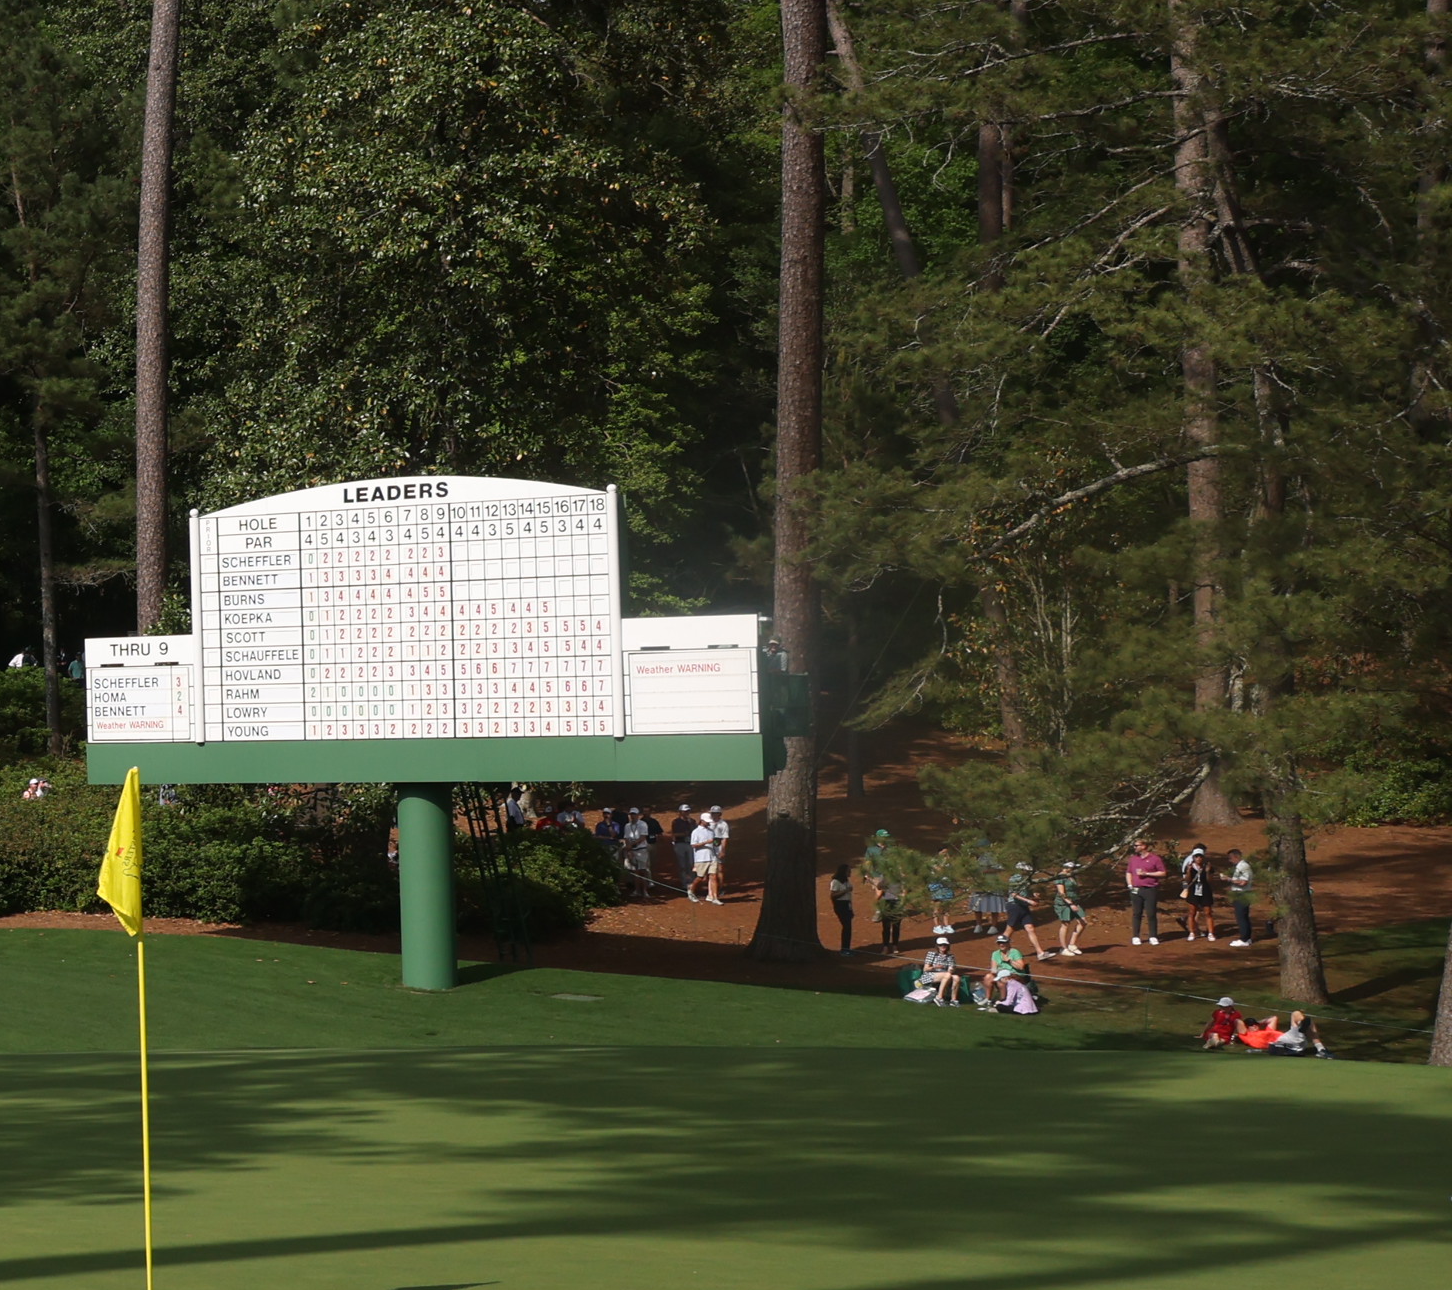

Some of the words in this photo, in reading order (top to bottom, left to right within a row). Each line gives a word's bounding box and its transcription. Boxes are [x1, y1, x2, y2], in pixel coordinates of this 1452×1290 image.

[344, 482, 448, 503] LEADERS
[239, 518, 277, 531] HOLE
[320, 514, 327, 527] 2
[336, 513, 344, 526] 3
[351, 513, 359, 524] 4
[367, 512, 375, 524] 5
[384, 510, 393, 523] 6
[403, 509, 411, 521] 7
[420, 508, 429, 521] 8
[436, 507, 445, 520] 9
[451, 506, 466, 519] 10
[470, 506, 480, 517] 11
[485, 504, 498, 517] 12
[502, 503, 516, 516] 13
[519, 503, 534, 515] 14
[536, 501, 551, 514] 15
[555, 500, 569, 513] 16
[572, 499, 586, 512] 17
[590, 498, 605, 511] 18
[246, 537, 272, 549] PAR
[305, 534, 312, 545] 4
[321, 533, 328, 545] 5
[336, 532, 344, 543] 4
[352, 531, 361, 544] 3
[368, 531, 376, 542] 4
[385, 529, 394, 542] 3
[404, 528, 412, 540] 4
[421, 527, 429, 540] 5
[437, 527, 445, 538] 4
[455, 526, 463, 537] 4
[471, 525, 480, 536] 4
[488, 523, 497, 536] 3
[506, 522, 514, 535] 5
[523, 522, 532, 533] 4
[540, 520, 548, 533] 5
[558, 519, 567, 532] 3
[576, 519, 584, 531] 4
[593, 518, 602, 530] 4
[222, 554, 291, 568] SCHEFFLER
[323, 552, 329, 564] 2
[338, 552, 343, 563] 2
[355, 551, 360, 562] 2
[370, 550, 375, 561] 2
[385, 549, 391, 560] 2
[408, 548, 413, 559] 2
[422, 547, 427, 559] 2
[438, 546, 444, 558] 3
[224, 574, 278, 586] BENNETT
[324, 571, 329, 583] 3
[339, 571, 344, 582] 3
[356, 570, 361, 581] 3
[371, 569, 376, 581] 3
[386, 568, 391, 579] 4
[408, 567, 413, 578] 4
[423, 567, 428, 577] 4
[439, 566, 444, 576] 4
[224, 594, 264, 606] BURNS
[324, 591, 329, 602] 3
[338, 590, 343, 601] 4
[356, 590, 360, 600] 4
[370, 589, 375, 599] 4
[386, 588, 391, 599] 4
[407, 588, 412, 598] 4
[423, 586, 429, 598] 5
[440, 586, 445, 597] 5
[224, 613, 272, 624] KOEPKA
[339, 609, 345, 620] 2
[356, 609, 362, 620] 2
[371, 608, 377, 619] 2
[387, 607, 392, 619] 2
[409, 606, 414, 618] 3
[423, 606, 428, 616] 4
[440, 606, 445, 616] 4
[459, 605, 464, 615] 4
[476, 604, 481, 615] 4
[491, 603, 496, 615] 5
[511, 603, 516, 613] 4
[526, 602, 531, 613] 4
[543, 601, 548, 613] 5
[226, 632, 265, 643] SCOTT
[340, 628, 345, 640] 2
[357, 628, 362, 639] 2
[372, 627, 377, 638] 2
[387, 627, 393, 638] 2
[410, 626, 415, 637] 2
[424, 625, 429, 636] 2
[440, 625, 446, 636] 2
[460, 624, 465, 636] 2
[475, 624, 480, 635] 2
[492, 623, 497, 635] 2
[511, 622, 517, 634] 2
[527, 621, 532, 633] 3
[543, 621, 549, 633] 5
[563, 620, 569, 632] 5
[580, 620, 586, 631] 5
[596, 620, 601, 631] 4
[110, 643, 150, 656] THRU
[159, 642, 168, 655] 9
[225, 650, 298, 662] SCHAUFFELE
[358, 647, 363, 658] 2
[372, 646, 377, 657] 2
[388, 646, 393, 657] 2
[441, 644, 446, 656] 2
[460, 643, 466, 655] 2
[475, 643, 481, 654] 2
[492, 642, 498, 653] 3
[512, 642, 518, 653] 3
[528, 642, 533, 652] 4
[544, 641, 549, 652] 5
[565, 640, 571, 652] 5
[581, 640, 586, 650] 4
[597, 639, 602, 650] 4
[226, 669, 281, 681] HOVLAND
[636, 666, 673, 674] Weather
[677, 663, 721, 673] WARNING
[94, 677, 159, 689] SCHEFFLER
[176, 677, 181, 687] 3
[94, 693, 127, 703] HOMA
[177, 691, 182, 701] 2
[226, 689, 260, 699] RAHM
[95, 706, 146, 717] BENNETT
[178, 705, 182, 714] 4
[226, 707, 267, 718] LOWRY
[130, 721, 164, 729] WARNING
[228, 726, 268, 737] YOUNG
